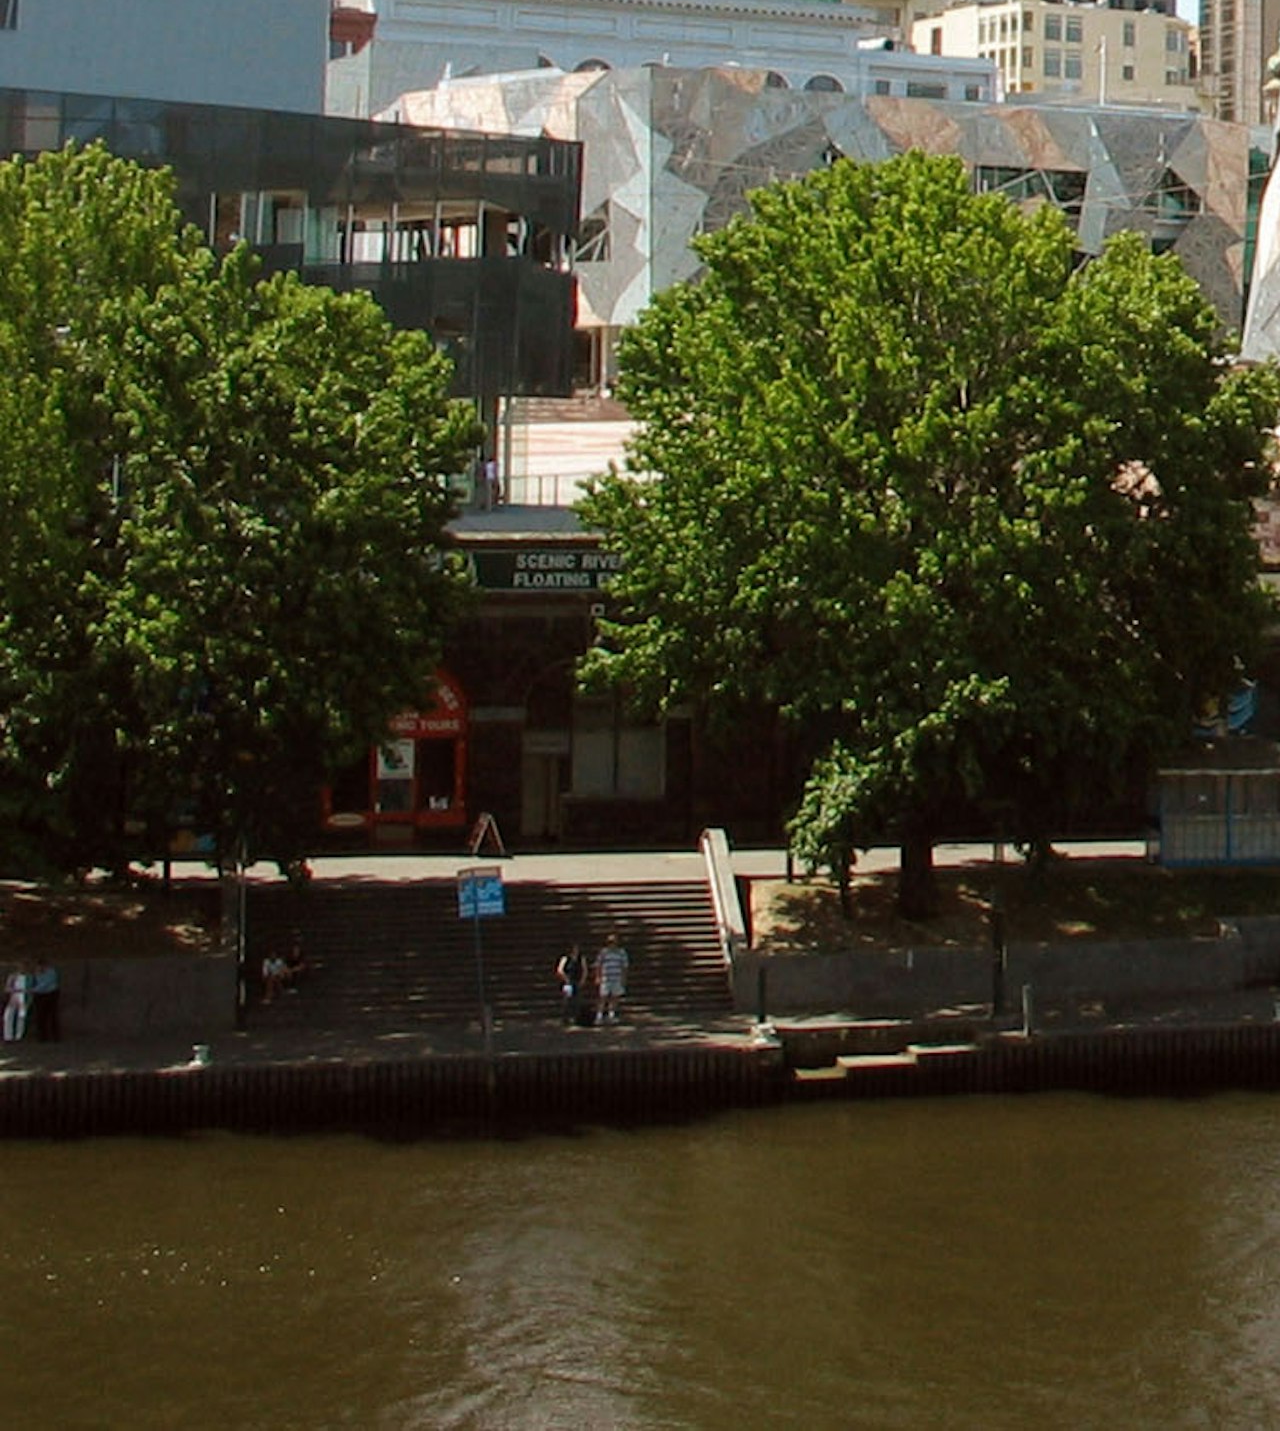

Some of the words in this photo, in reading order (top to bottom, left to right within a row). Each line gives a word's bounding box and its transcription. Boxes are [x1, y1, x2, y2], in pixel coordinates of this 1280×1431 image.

[515, 553, 576, 569] SCENIC
[512, 571, 590, 587] FLOATING
[420, 719, 460, 731] TOURS
